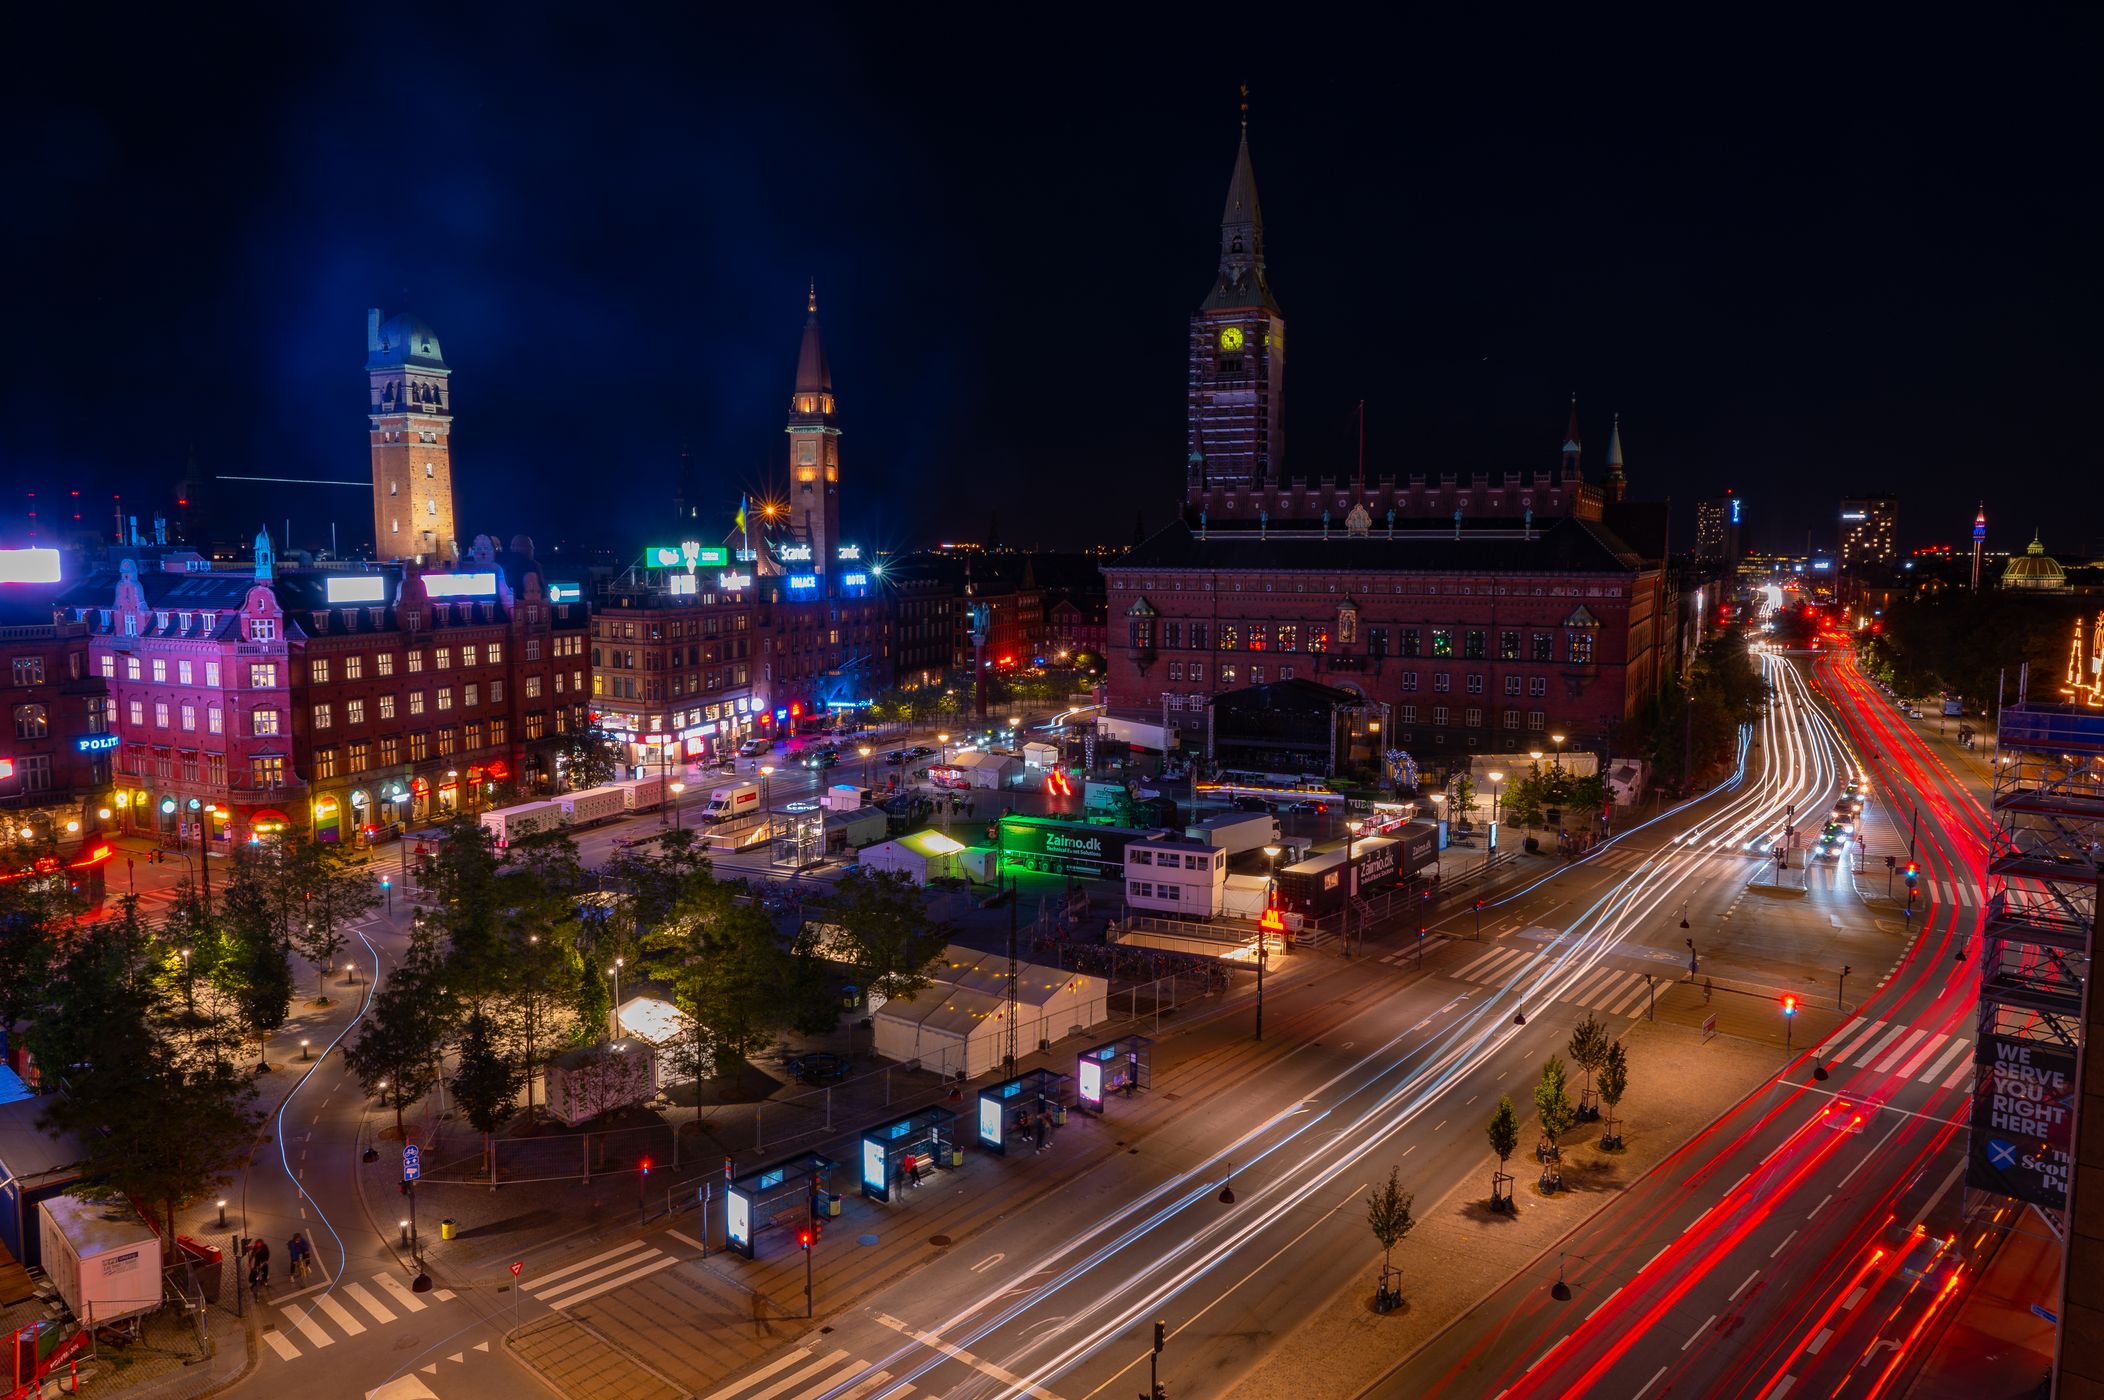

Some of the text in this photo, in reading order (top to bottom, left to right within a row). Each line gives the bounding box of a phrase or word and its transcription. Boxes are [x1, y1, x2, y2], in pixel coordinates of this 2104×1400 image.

[791, 576, 816, 588] PALACE
[846, 574, 867, 586] HOTEL
[1046, 832, 1102, 851] Zaimo.dk
[1996, 1042, 2031, 1064] WE
[1994, 1061, 2065, 1089] SERVE
[1993, 1077, 2044, 1102] YOU
[1993, 1094, 2065, 1125] RIGHT
[1991, 1111, 2049, 1139] HERE
[2021, 1154, 2068, 1178] Scot
[2051, 1148, 2069, 1163] Th
[2042, 1174, 2068, 1194] Pu
